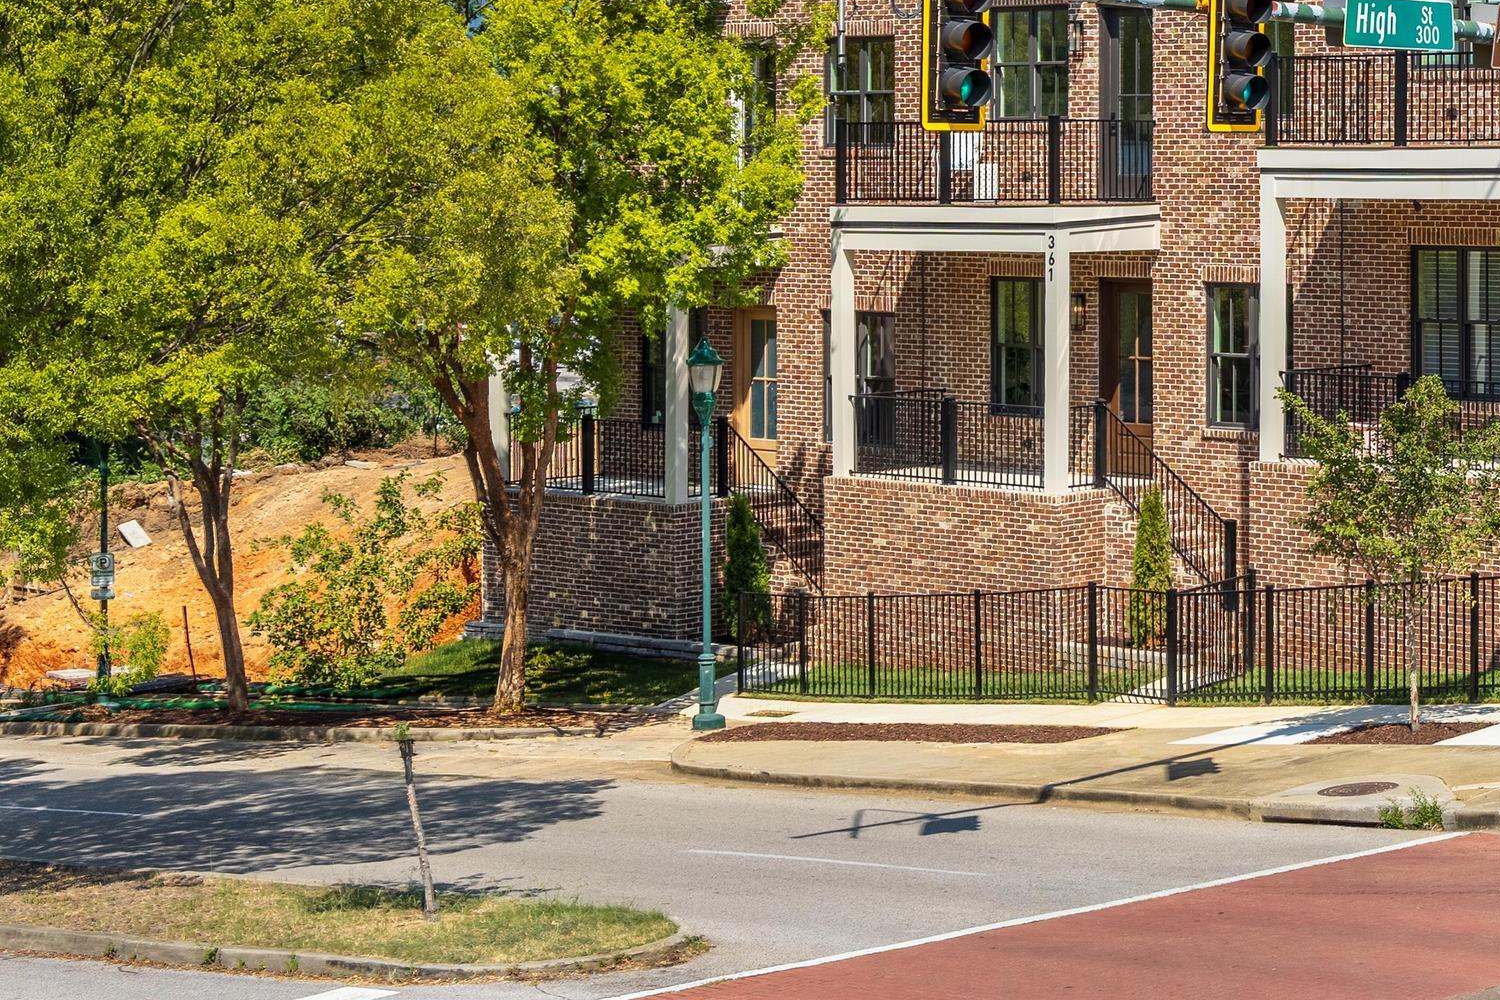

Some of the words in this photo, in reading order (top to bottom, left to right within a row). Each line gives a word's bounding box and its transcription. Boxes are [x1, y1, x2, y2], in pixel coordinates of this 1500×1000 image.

[1356, 2, 1397, 44] High
[1421, 5, 1433, 25] St
[1415, 25, 1440, 45] 300
[1047, 235, 1055, 282] 361
